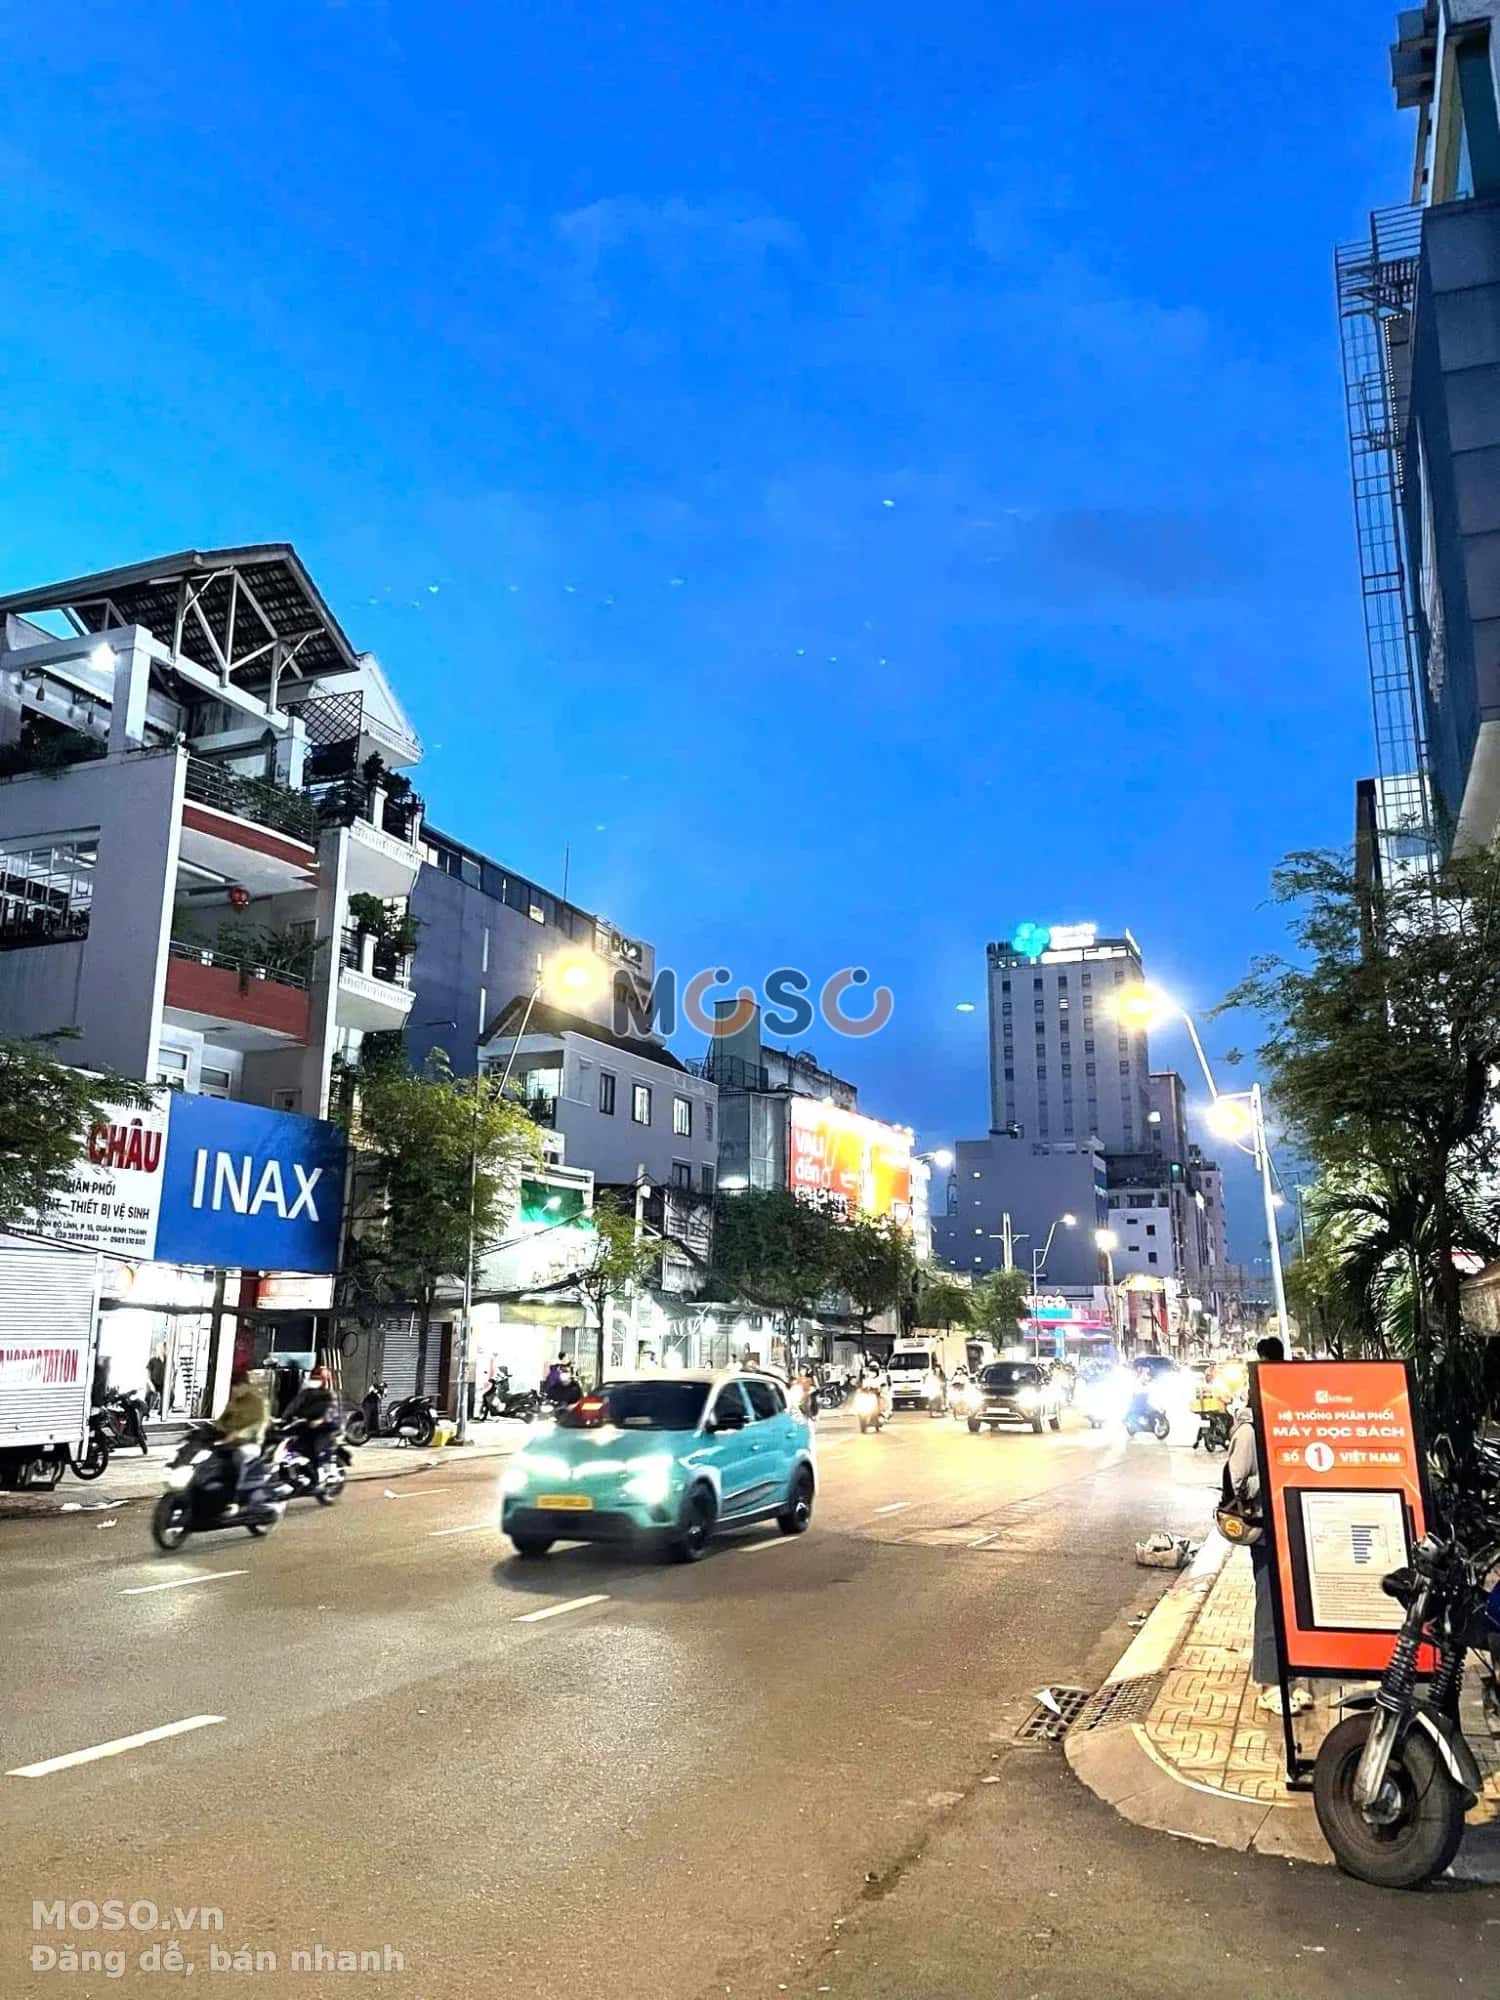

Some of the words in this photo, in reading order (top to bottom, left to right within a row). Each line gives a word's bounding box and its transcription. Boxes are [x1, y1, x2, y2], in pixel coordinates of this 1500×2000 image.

[88, 1117, 162, 1173] CHÂU
[66, 1177, 90, 1194] HÂN
[91, 1180, 116, 1197] PHỐI
[193, 1148, 323, 1222] INAX
[70, 1198, 99, 1215] THIẾT
[101, 1206, 111, 1219] BỊ
[113, 1203, 126, 1221] VỆ
[127, 1206, 150, 1220] SINH
[1277, 1409, 1293, 1422] HỆ
[1295, 1408, 1333, 1421] THỐNG
[1335, 1409, 1366, 1421] PHÂN
[1367, 1408, 1395, 1421] PHỐI
[1273, 1424, 1312, 1437] MÁY
[1355, 1425, 1405, 1438] SÁCH
[1281, 1448, 1300, 1463] SỐ
[1313, 1446, 1324, 1467] 1
[1339, 1449, 1367, 1463] VIỆT
[1368, 1452, 1400, 1464] NAM
